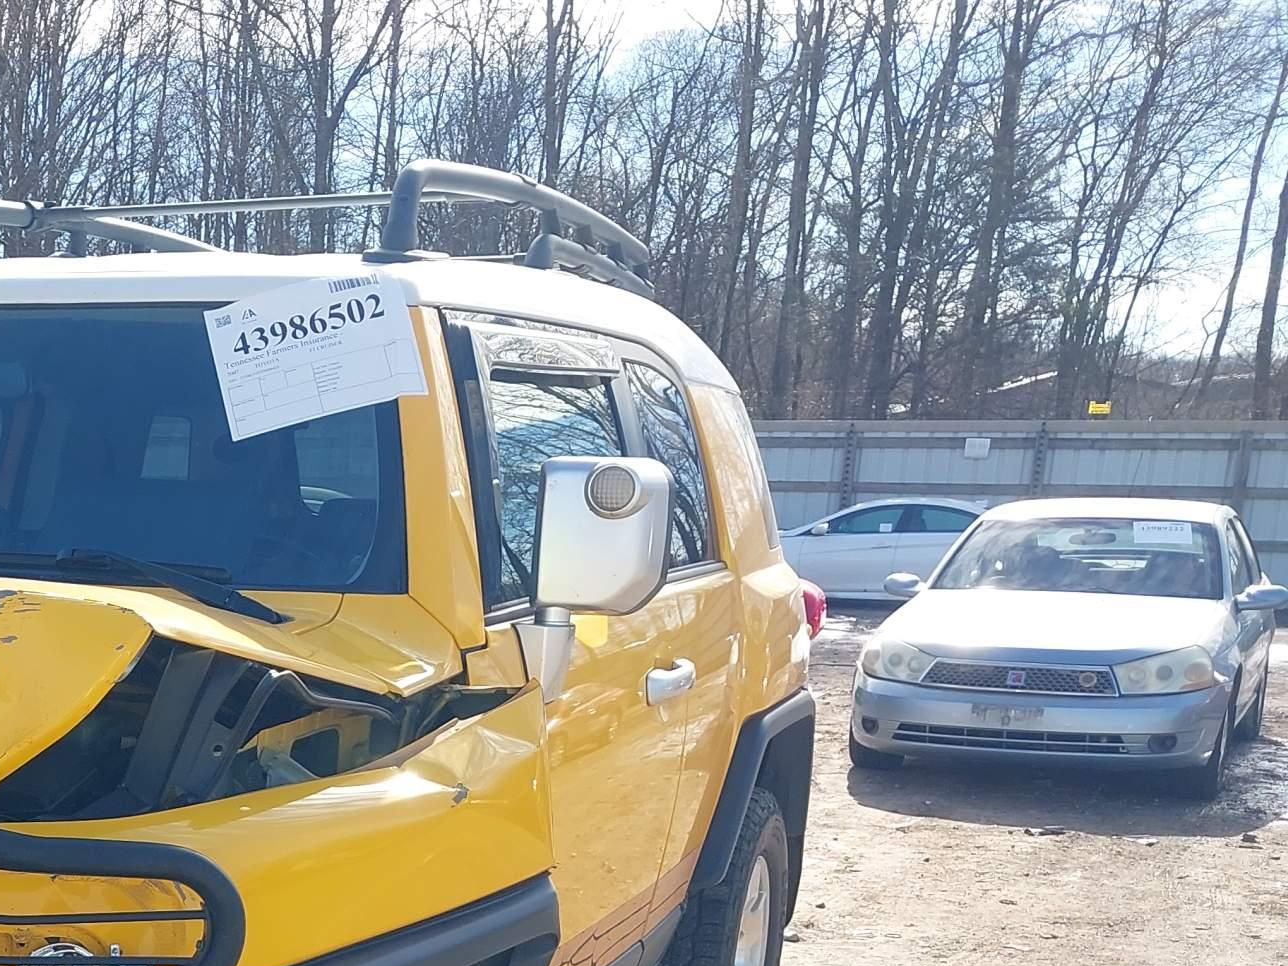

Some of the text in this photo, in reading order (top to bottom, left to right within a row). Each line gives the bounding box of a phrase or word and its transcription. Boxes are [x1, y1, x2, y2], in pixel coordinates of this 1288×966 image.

[233, 294, 385, 355] 43986502
[224, 353, 264, 369] Tennessee
[266, 344, 299, 357] Farmers
[300, 333, 339, 347] Insurance
